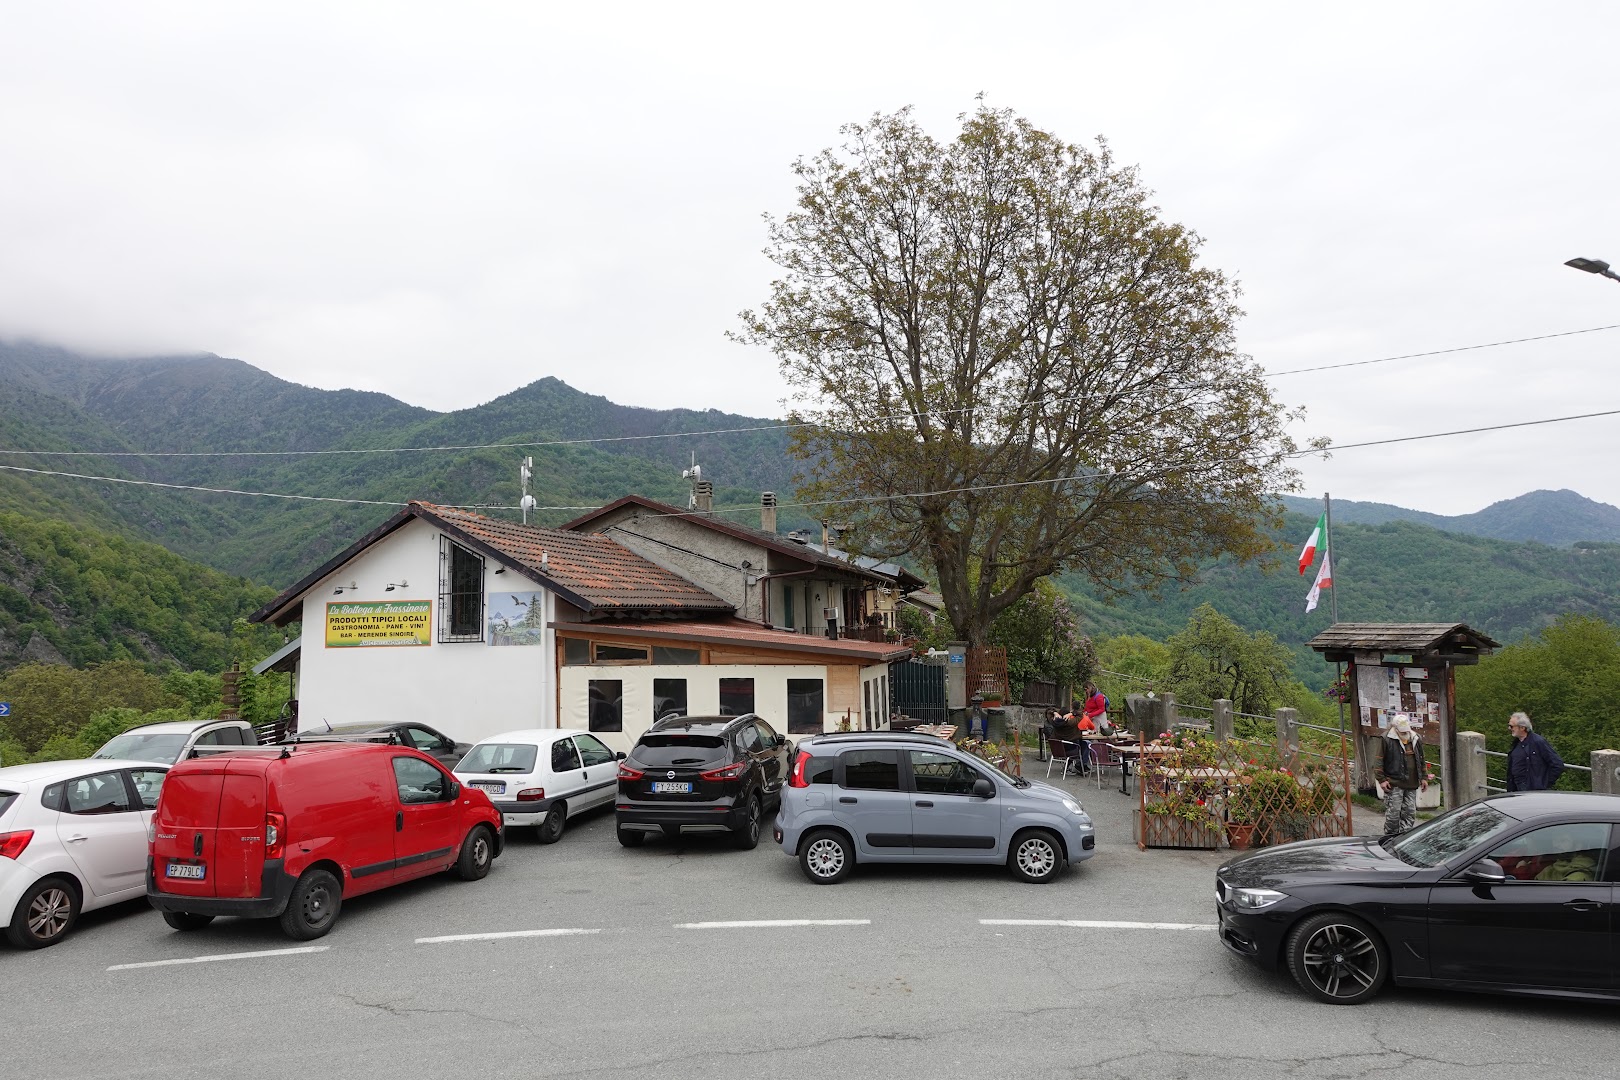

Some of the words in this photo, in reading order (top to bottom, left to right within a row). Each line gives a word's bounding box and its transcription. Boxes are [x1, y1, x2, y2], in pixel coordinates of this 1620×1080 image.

[328, 606, 338, 614] La
[341, 604, 372, 615] Bottega
[375, 606, 382, 614] di
[384, 603, 428, 613] Frassinere
[170, 865, 178, 876] EP
[180, 866, 200, 877] 779LC
